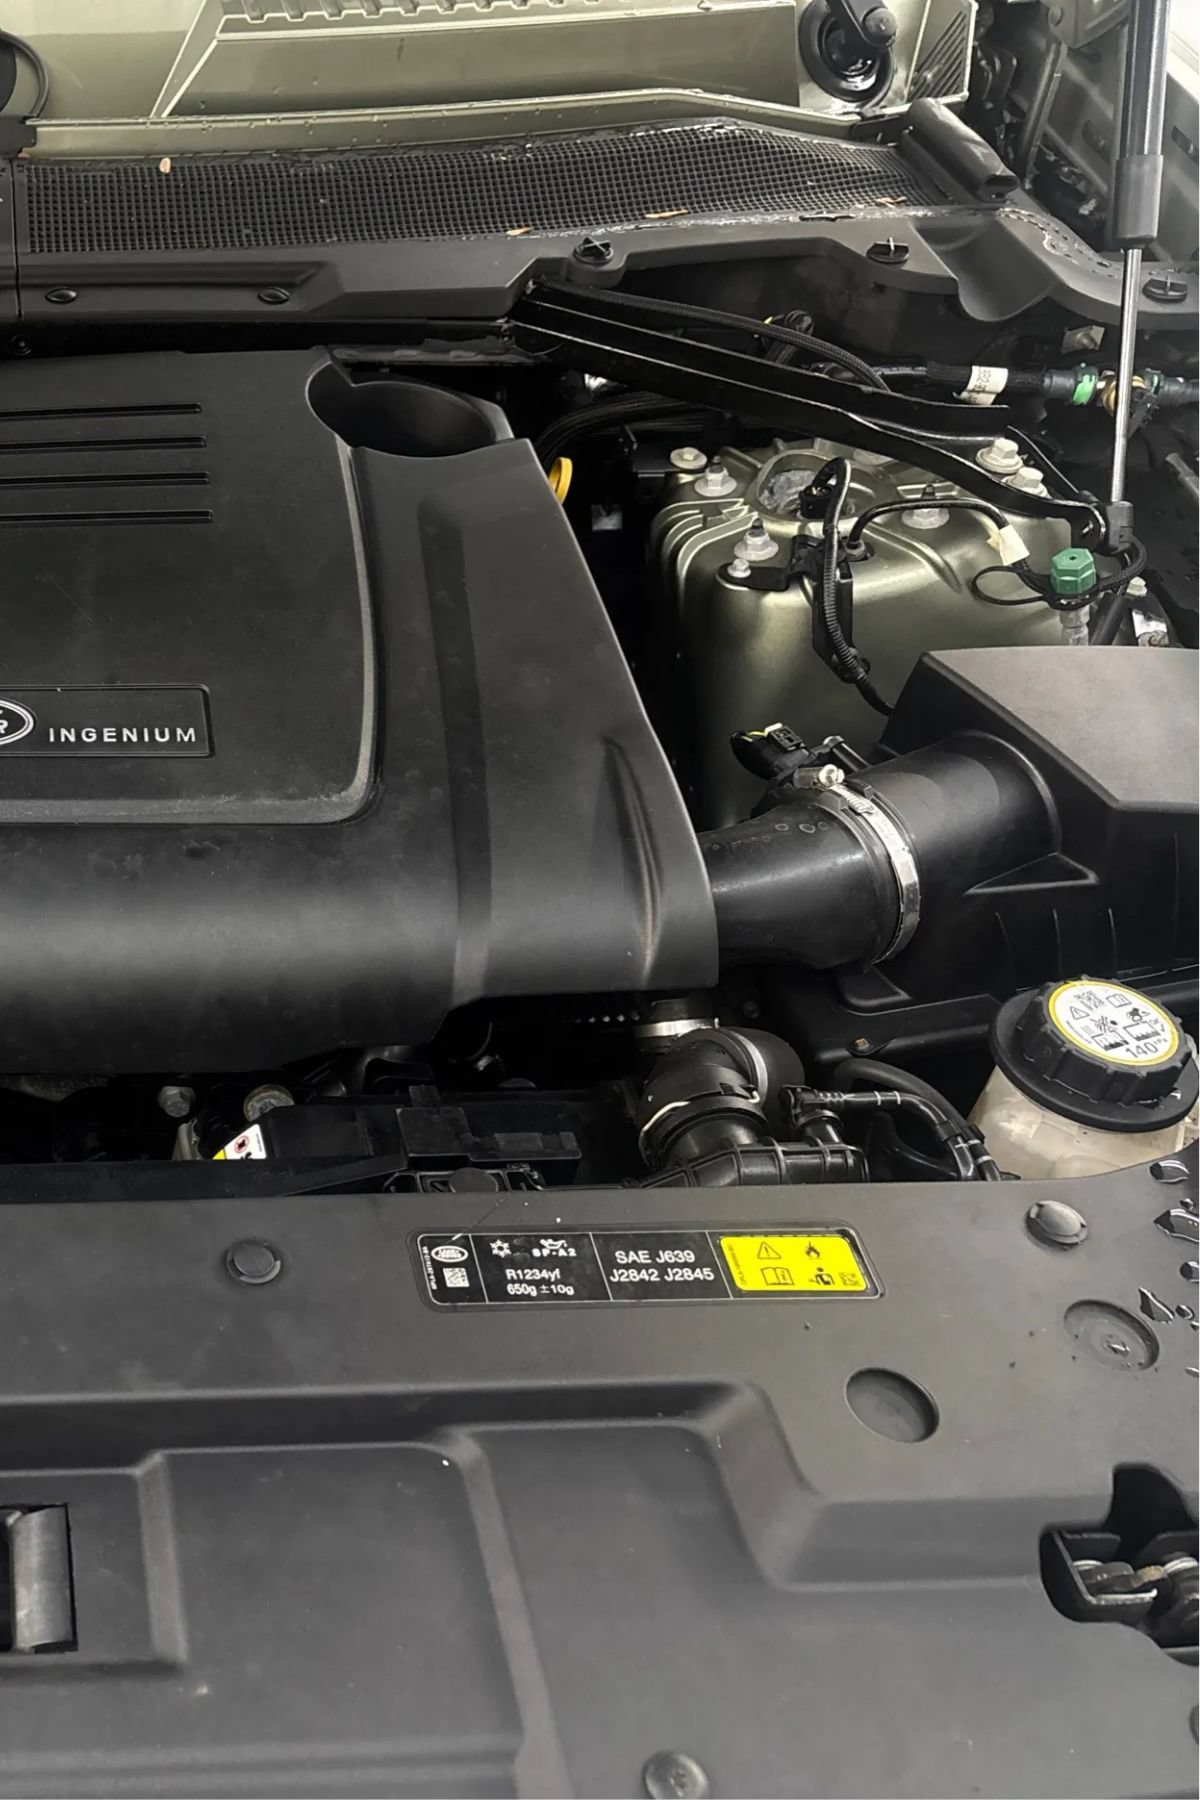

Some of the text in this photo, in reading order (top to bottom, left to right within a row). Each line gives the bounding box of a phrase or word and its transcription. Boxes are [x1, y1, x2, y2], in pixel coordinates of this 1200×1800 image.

[49, 727, 196, 743] INGENIUM
[1125, 1042, 1158, 1058] 140
[615, 1249, 696, 1264] SAE J639
[505, 1268, 561, 1282] R1234yf
[609, 1267, 715, 1282] J2842 J2845
[506, 1283, 537, 1297] 650g
